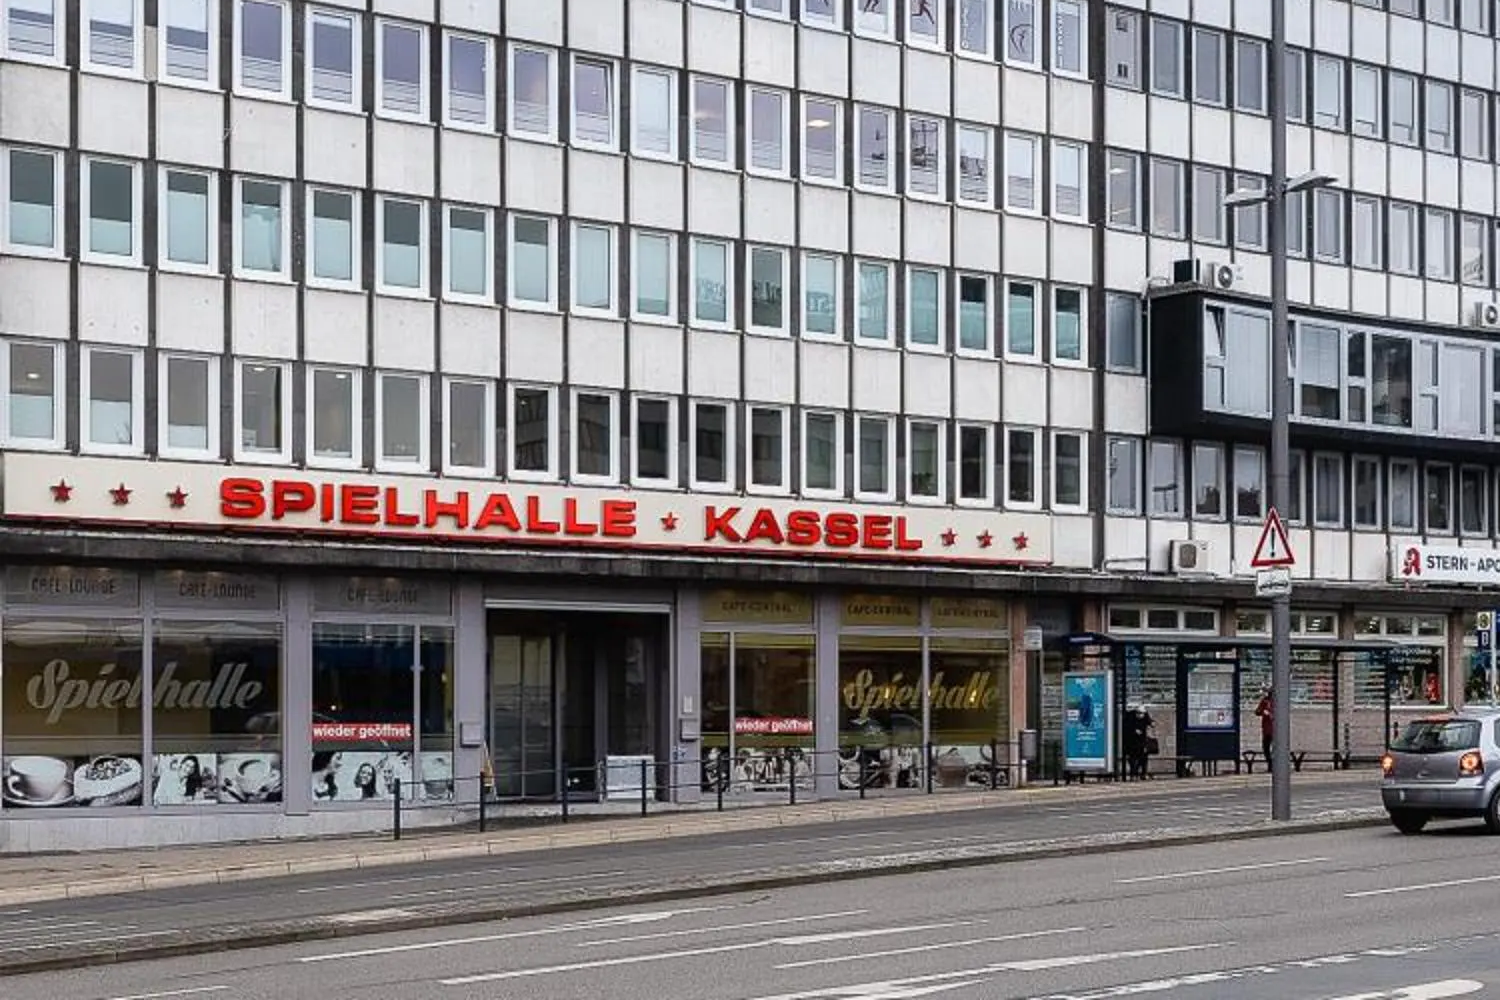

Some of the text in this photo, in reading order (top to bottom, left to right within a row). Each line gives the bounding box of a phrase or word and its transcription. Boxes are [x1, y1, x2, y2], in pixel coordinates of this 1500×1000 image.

[219, 476, 923, 550] SPIELHALLE KASSEL
[26, 657, 264, 725] Spielhalle
[313, 723, 412, 739] wieder geöffnet
[735, 716, 814, 733] wieder geöffnet
